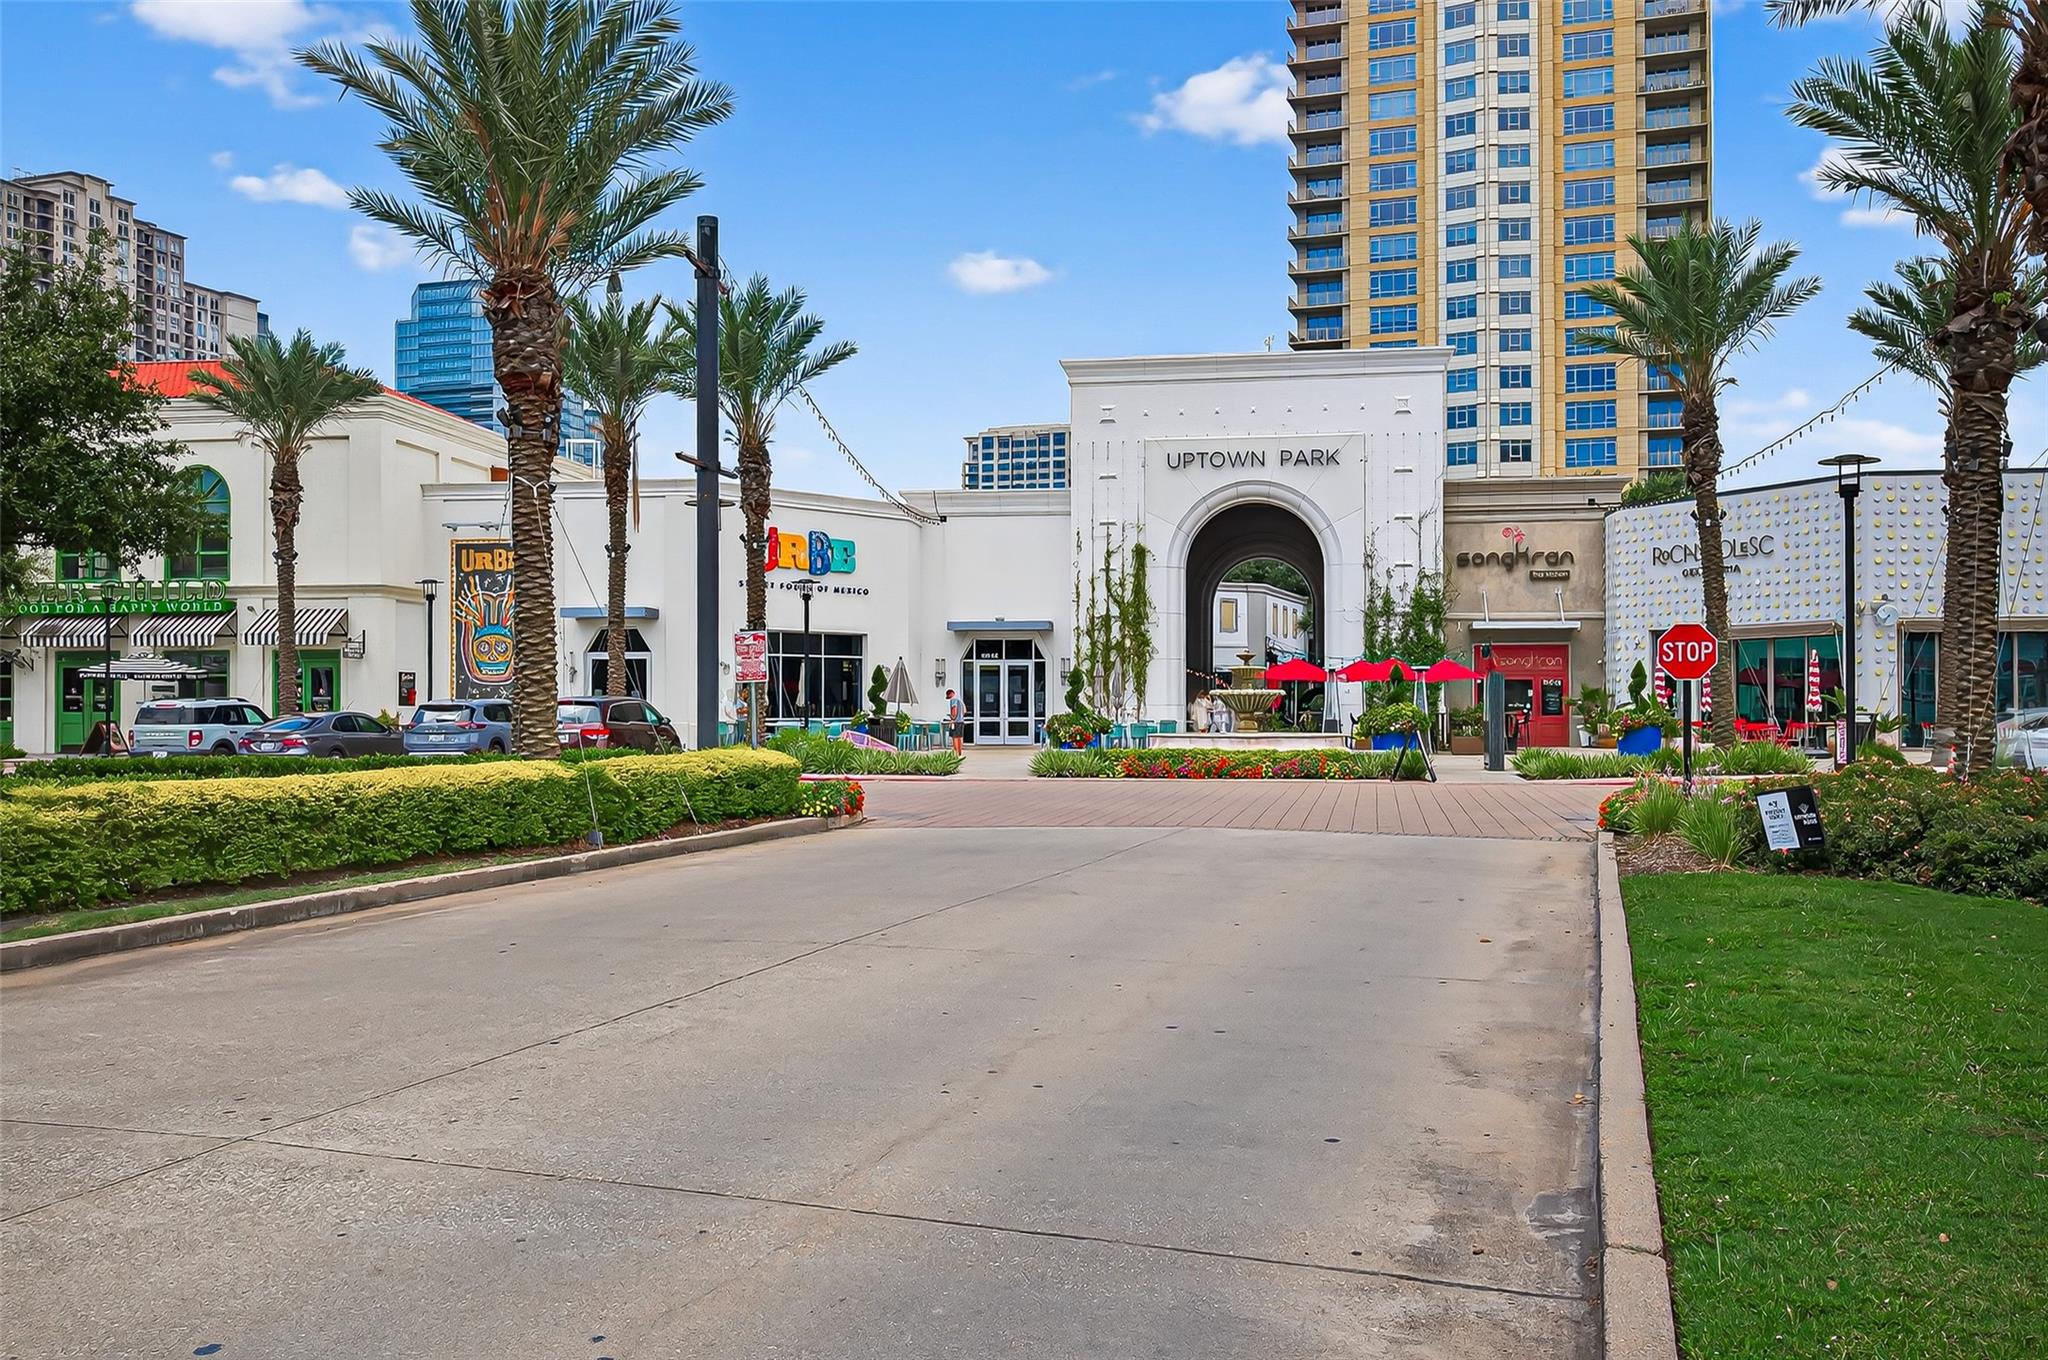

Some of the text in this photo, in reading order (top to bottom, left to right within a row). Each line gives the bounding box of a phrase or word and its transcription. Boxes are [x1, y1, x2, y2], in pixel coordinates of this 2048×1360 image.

[1167, 448, 1340, 469] UPTOWN PARK
[834, 586, 869, 596] MEXICO
[18, 604, 50, 614] OOD
[166, 602, 222, 613] WORLD
[1662, 641, 1713, 663] STOP
